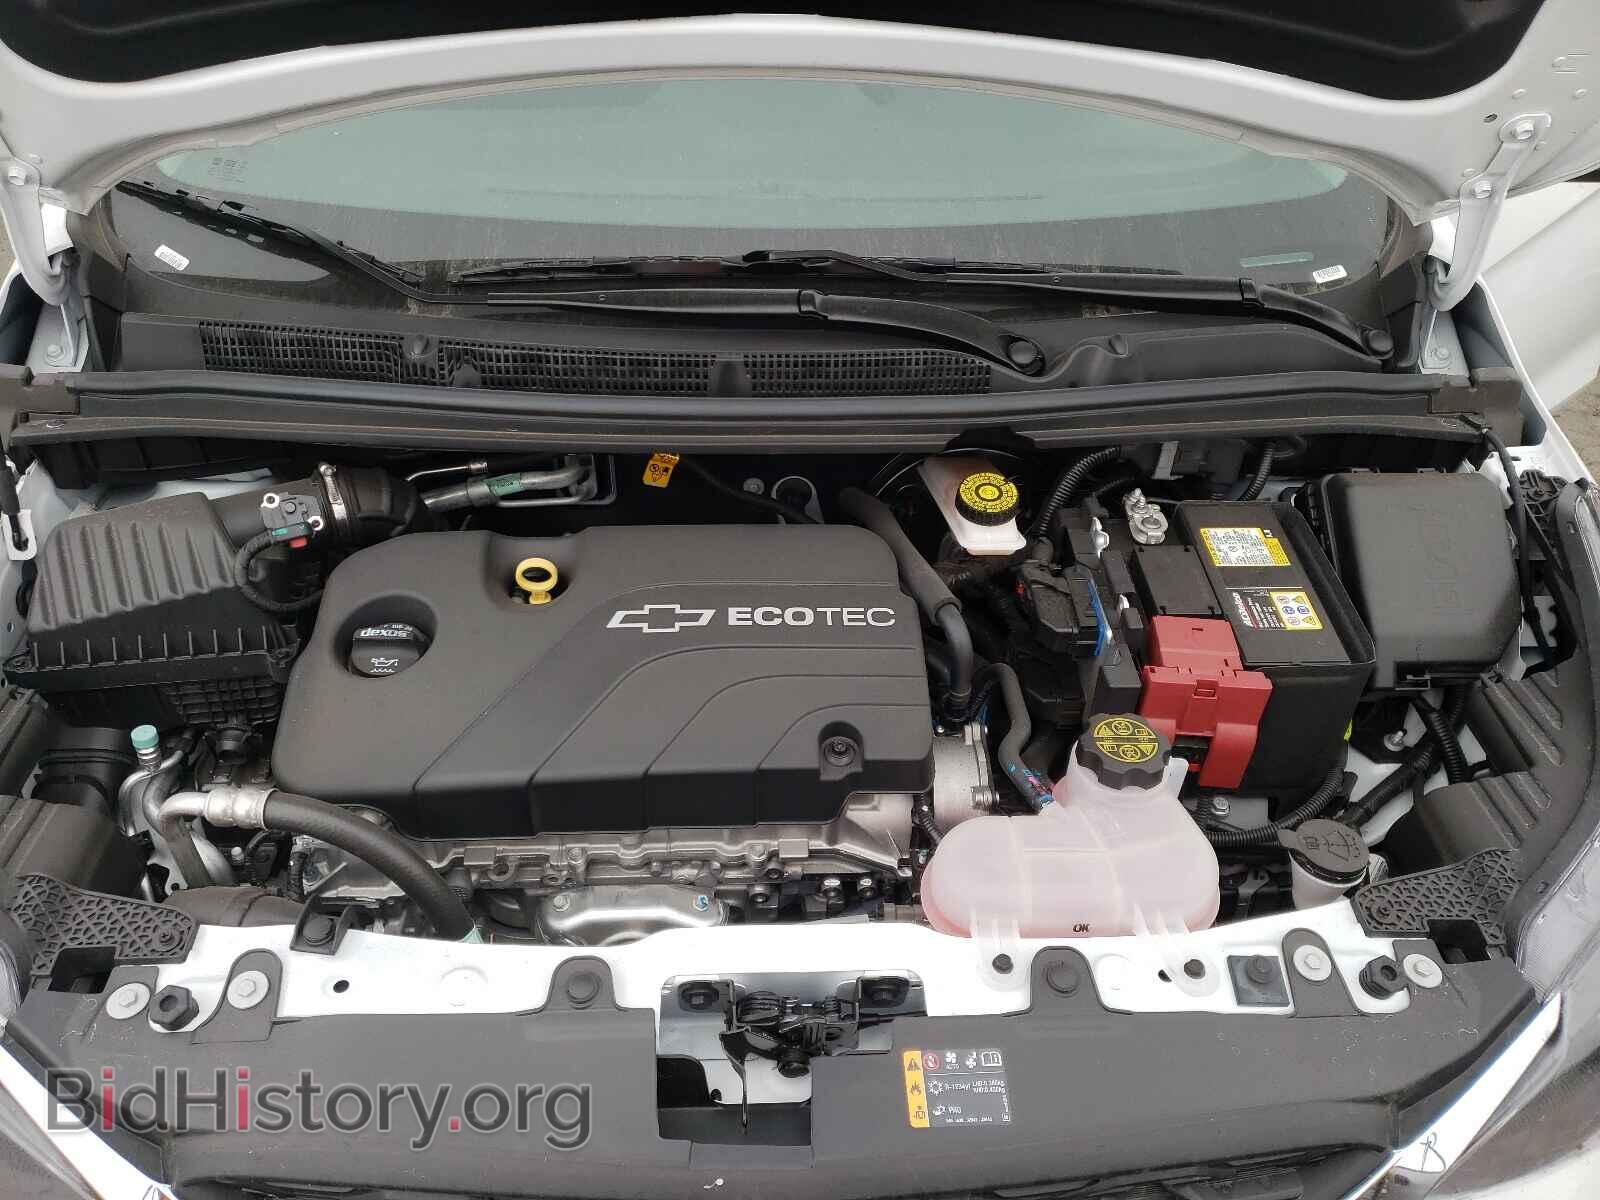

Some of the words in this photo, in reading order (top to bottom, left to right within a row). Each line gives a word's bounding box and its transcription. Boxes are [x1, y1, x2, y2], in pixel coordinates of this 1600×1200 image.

[727, 606, 896, 627] ECOTEC
[360, 627, 409, 638] dexos
[1072, 923, 1090, 933] OK
